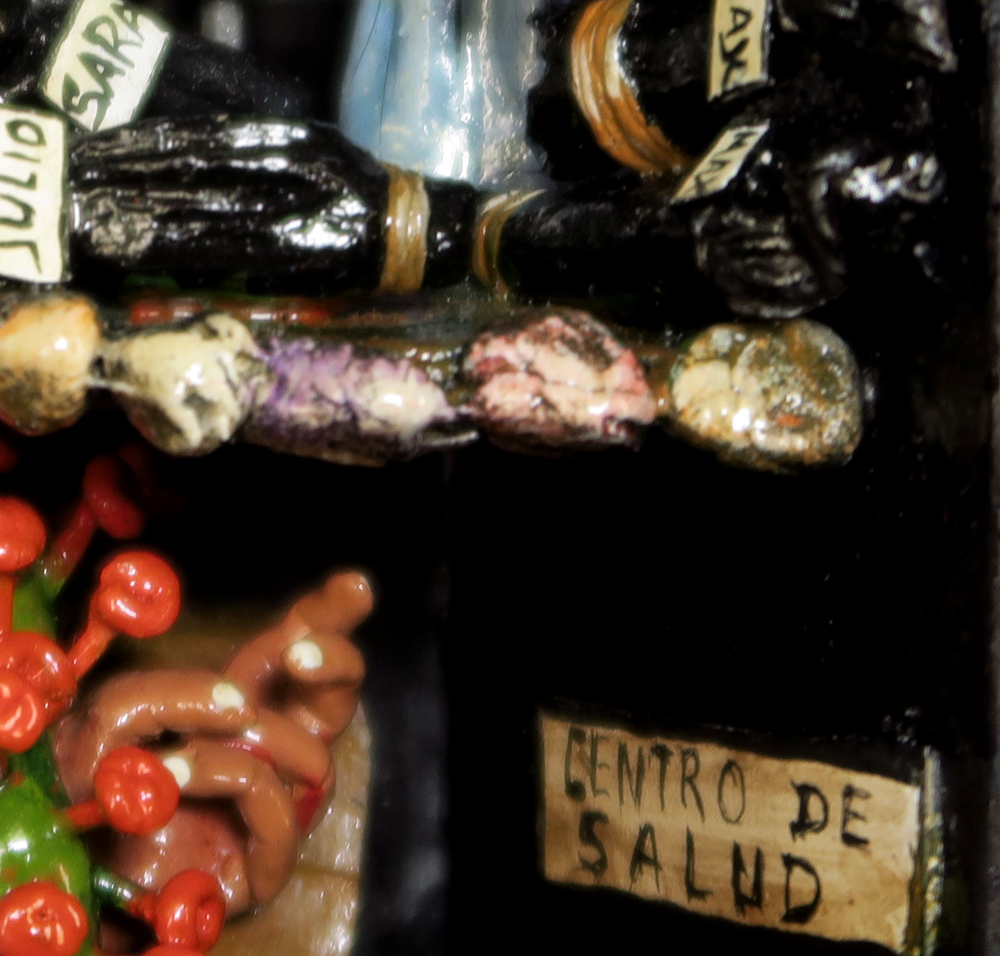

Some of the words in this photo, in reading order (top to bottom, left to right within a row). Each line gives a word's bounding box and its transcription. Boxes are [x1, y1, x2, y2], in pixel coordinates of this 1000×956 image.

[62, 3, 157, 129] SARA
[563, 726, 746, 825] CENTRO
[790, 779, 871, 848] DE
[577, 810, 822, 925] SALUD
